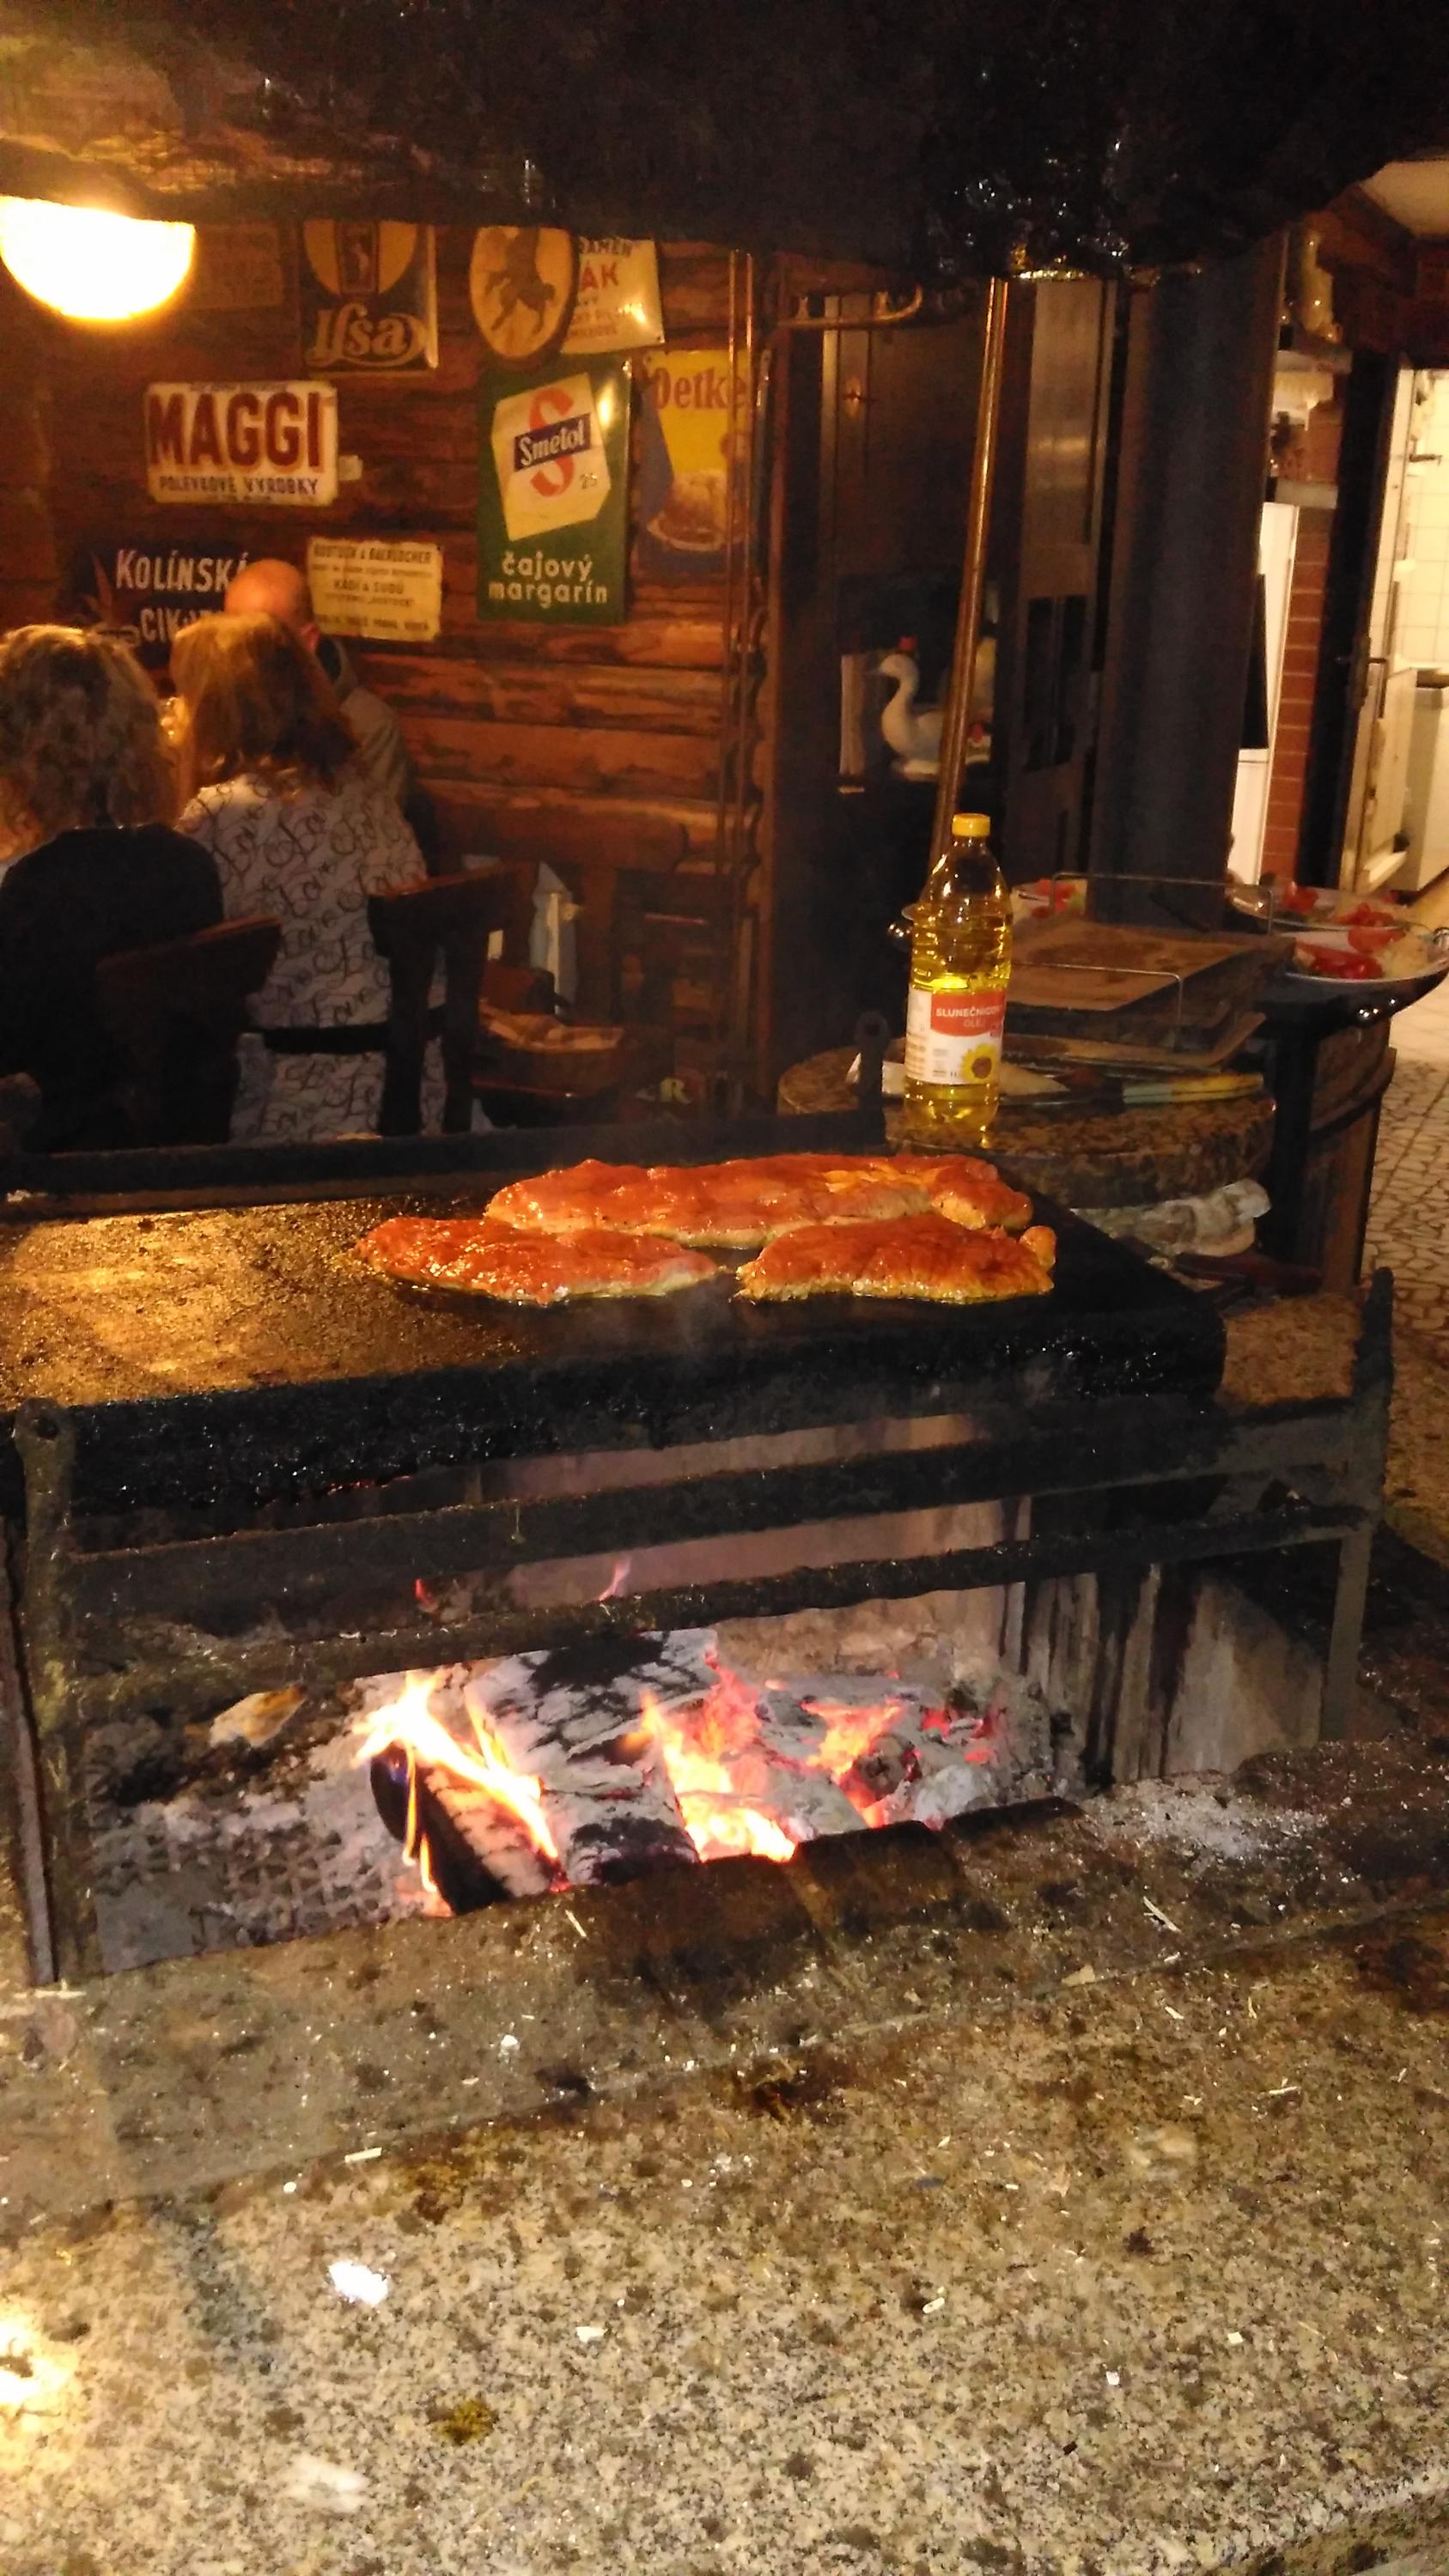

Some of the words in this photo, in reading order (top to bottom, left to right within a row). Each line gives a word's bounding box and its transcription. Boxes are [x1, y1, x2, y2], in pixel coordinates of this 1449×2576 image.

[654, 368, 750, 410] Oetke
[148, 392, 321, 469] MAGGI
[519, 419, 585, 466] Smetol
[502, 550, 593, 582] čajový
[488, 580, 608, 609] margarín
[935, 1005, 1003, 1018] SLUNEČNICOV
